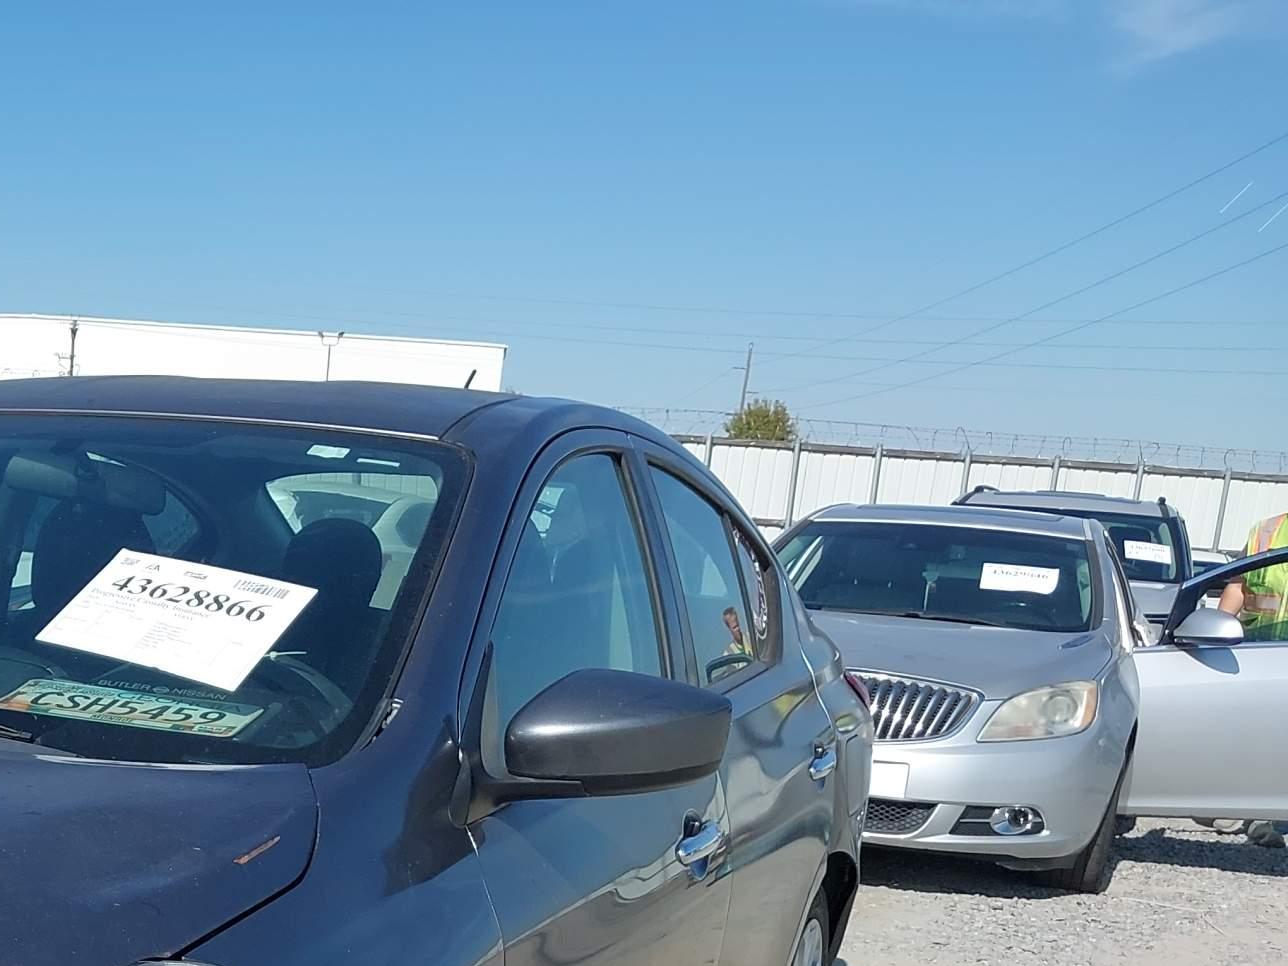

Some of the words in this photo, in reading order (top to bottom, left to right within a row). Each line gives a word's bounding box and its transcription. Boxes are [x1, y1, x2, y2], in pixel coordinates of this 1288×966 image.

[112, 575, 272, 622] 43628866
[98, 679, 152, 692] BUTLER
[172, 687, 227, 700] NISSAN
[30, 691, 227, 725] CSH5459
